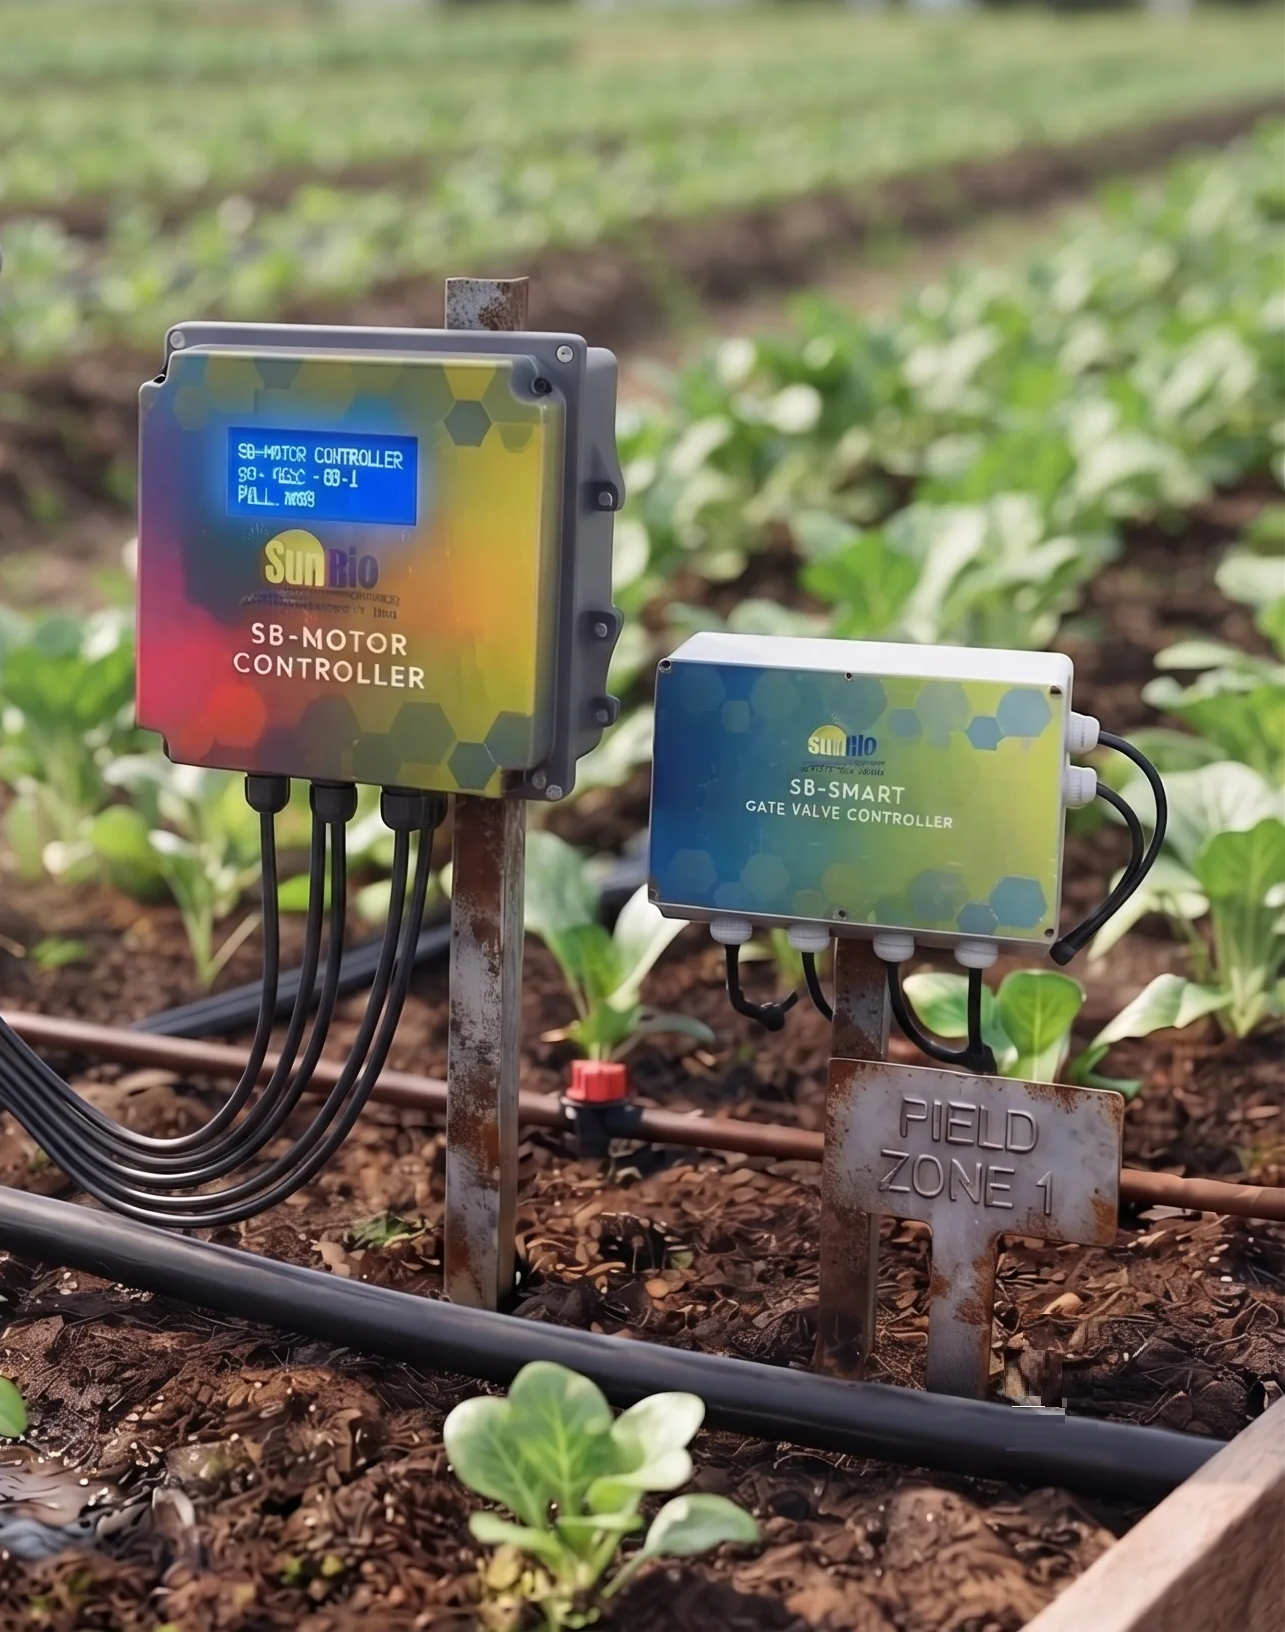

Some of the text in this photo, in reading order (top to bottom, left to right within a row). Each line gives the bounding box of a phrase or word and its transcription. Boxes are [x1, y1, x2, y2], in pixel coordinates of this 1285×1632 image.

[314, 446, 404, 470] CONTROLLER
[251, 622, 408, 656] SB-MOTOR
[233, 652, 426, 690] CONTROLLER
[789, 778, 906, 805] SB-SMART
[745, 800, 954, 829] GATE VALVE CONTROLLER
[878, 1149, 1053, 1216] ZONE 1
